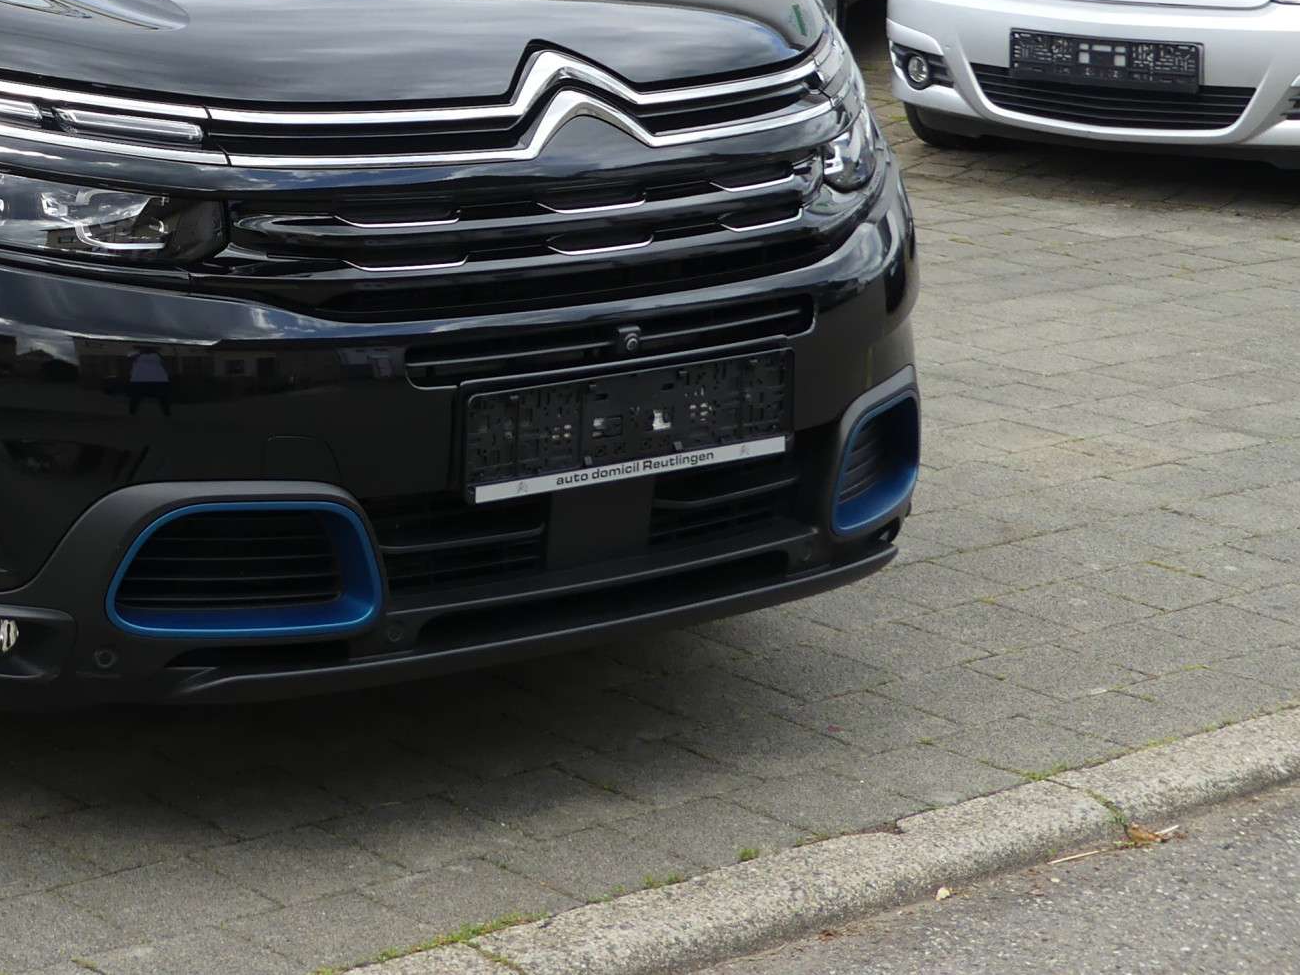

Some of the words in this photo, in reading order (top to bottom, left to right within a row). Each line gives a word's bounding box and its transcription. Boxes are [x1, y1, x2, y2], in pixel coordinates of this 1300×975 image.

[556, 471, 589, 486] auto
[591, 464, 640, 480] domicil
[643, 450, 715, 471] Reutlingen
